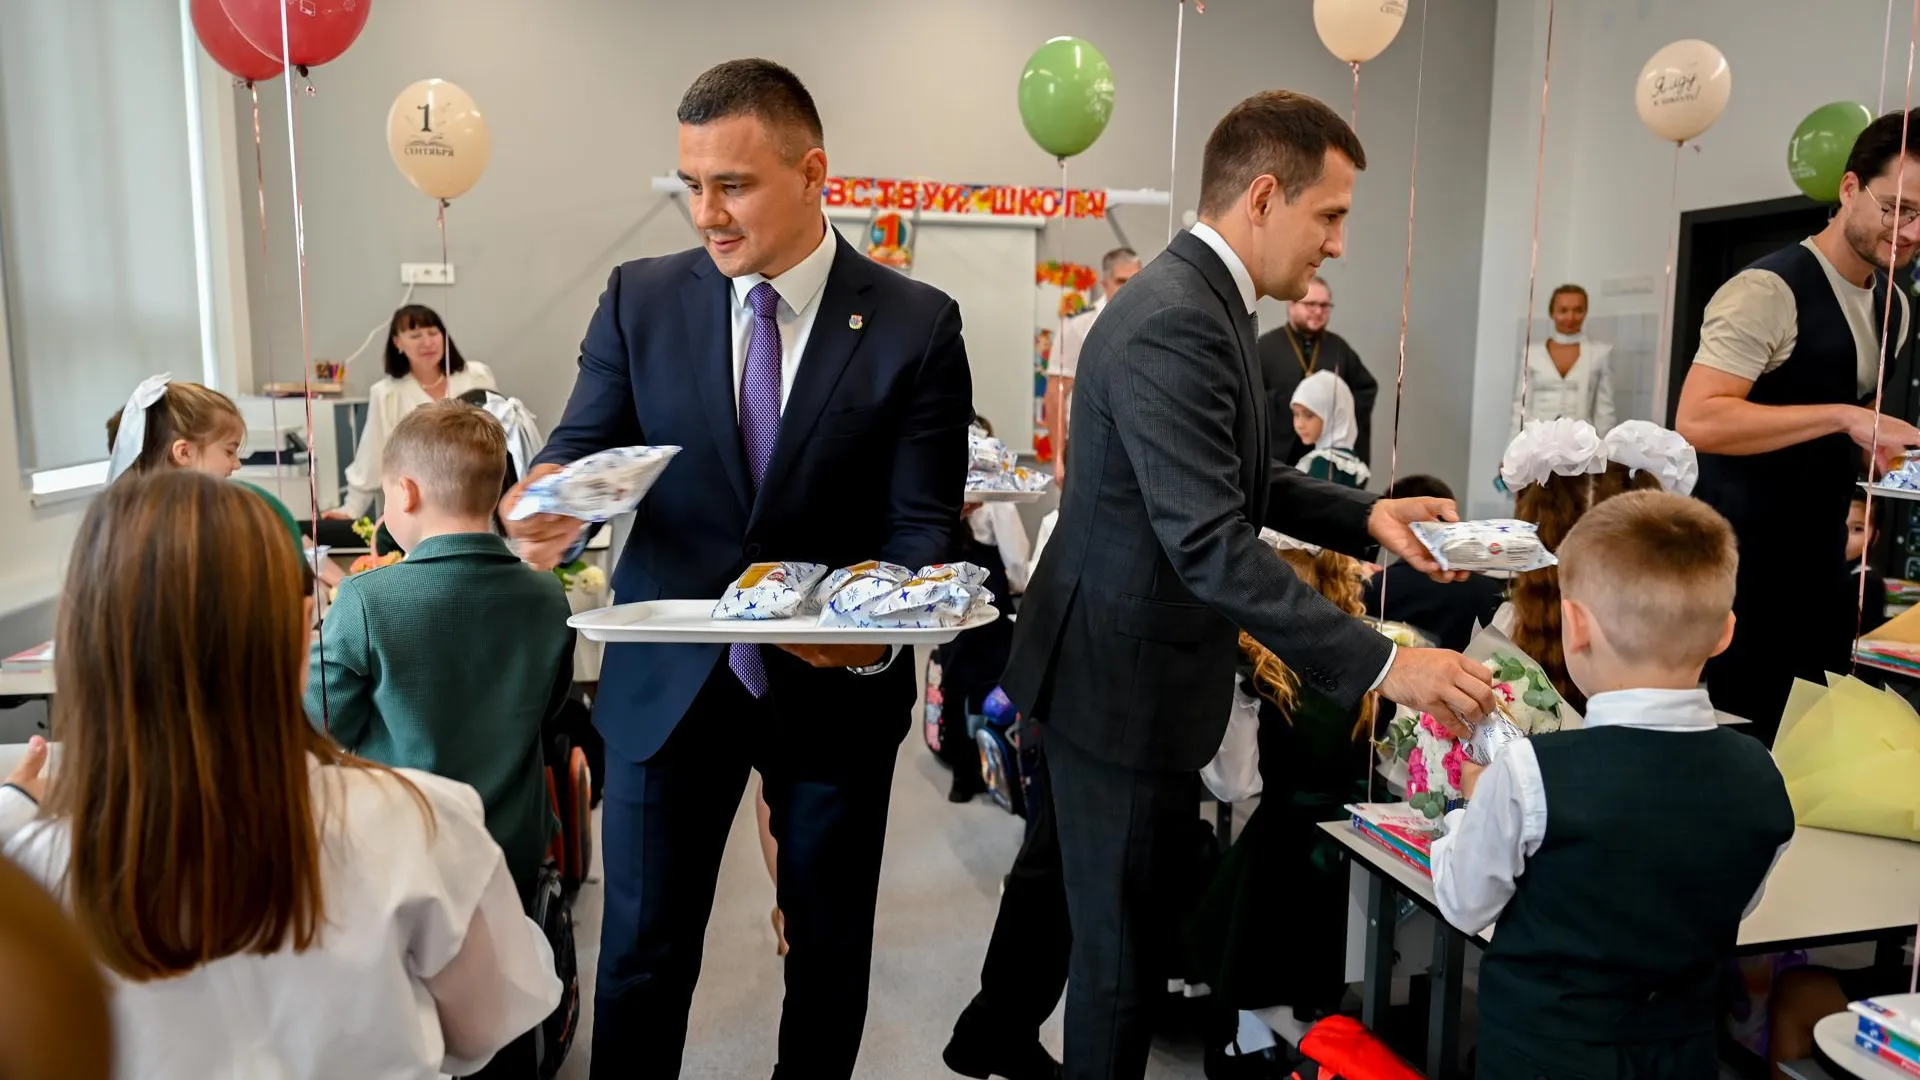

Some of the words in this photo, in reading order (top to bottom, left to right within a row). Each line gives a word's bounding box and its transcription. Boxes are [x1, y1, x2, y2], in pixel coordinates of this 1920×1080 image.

[416, 103, 432, 132] 1
[825, 177, 970, 214] ВСТВУЙ,
[875, 213, 902, 253] 1
